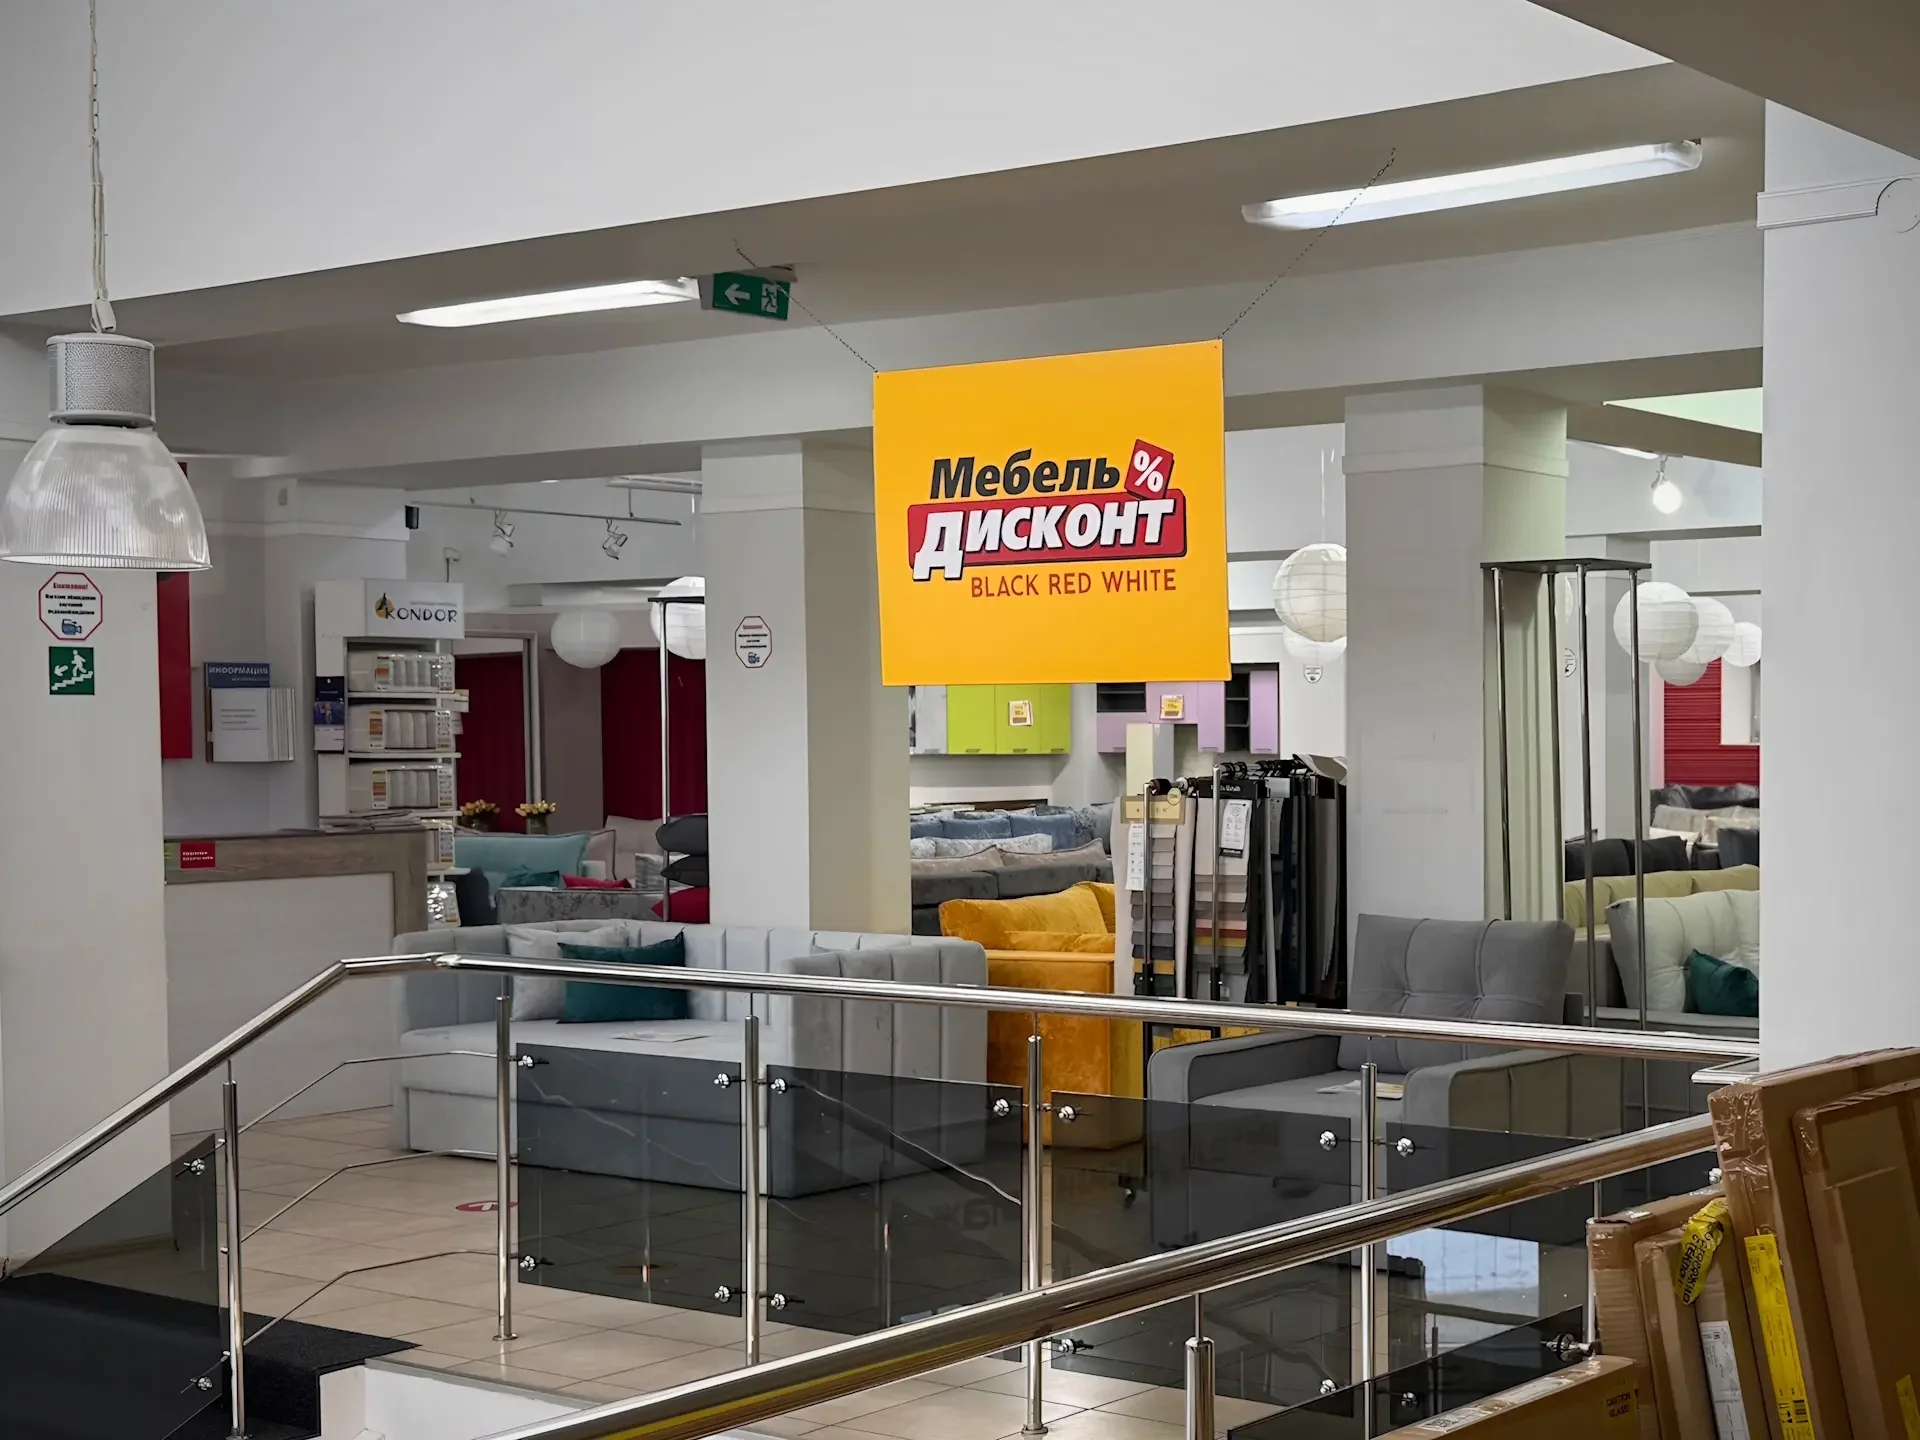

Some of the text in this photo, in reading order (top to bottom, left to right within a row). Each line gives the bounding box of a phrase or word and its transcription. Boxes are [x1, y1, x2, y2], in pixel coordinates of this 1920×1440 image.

[929, 447, 1164, 499] Мебель %
[911, 497, 1175, 580] ДИСКОНТ
[970, 568, 1177, 598] BLACK RED WHITE
[385, 607, 457, 622] KONDOR
